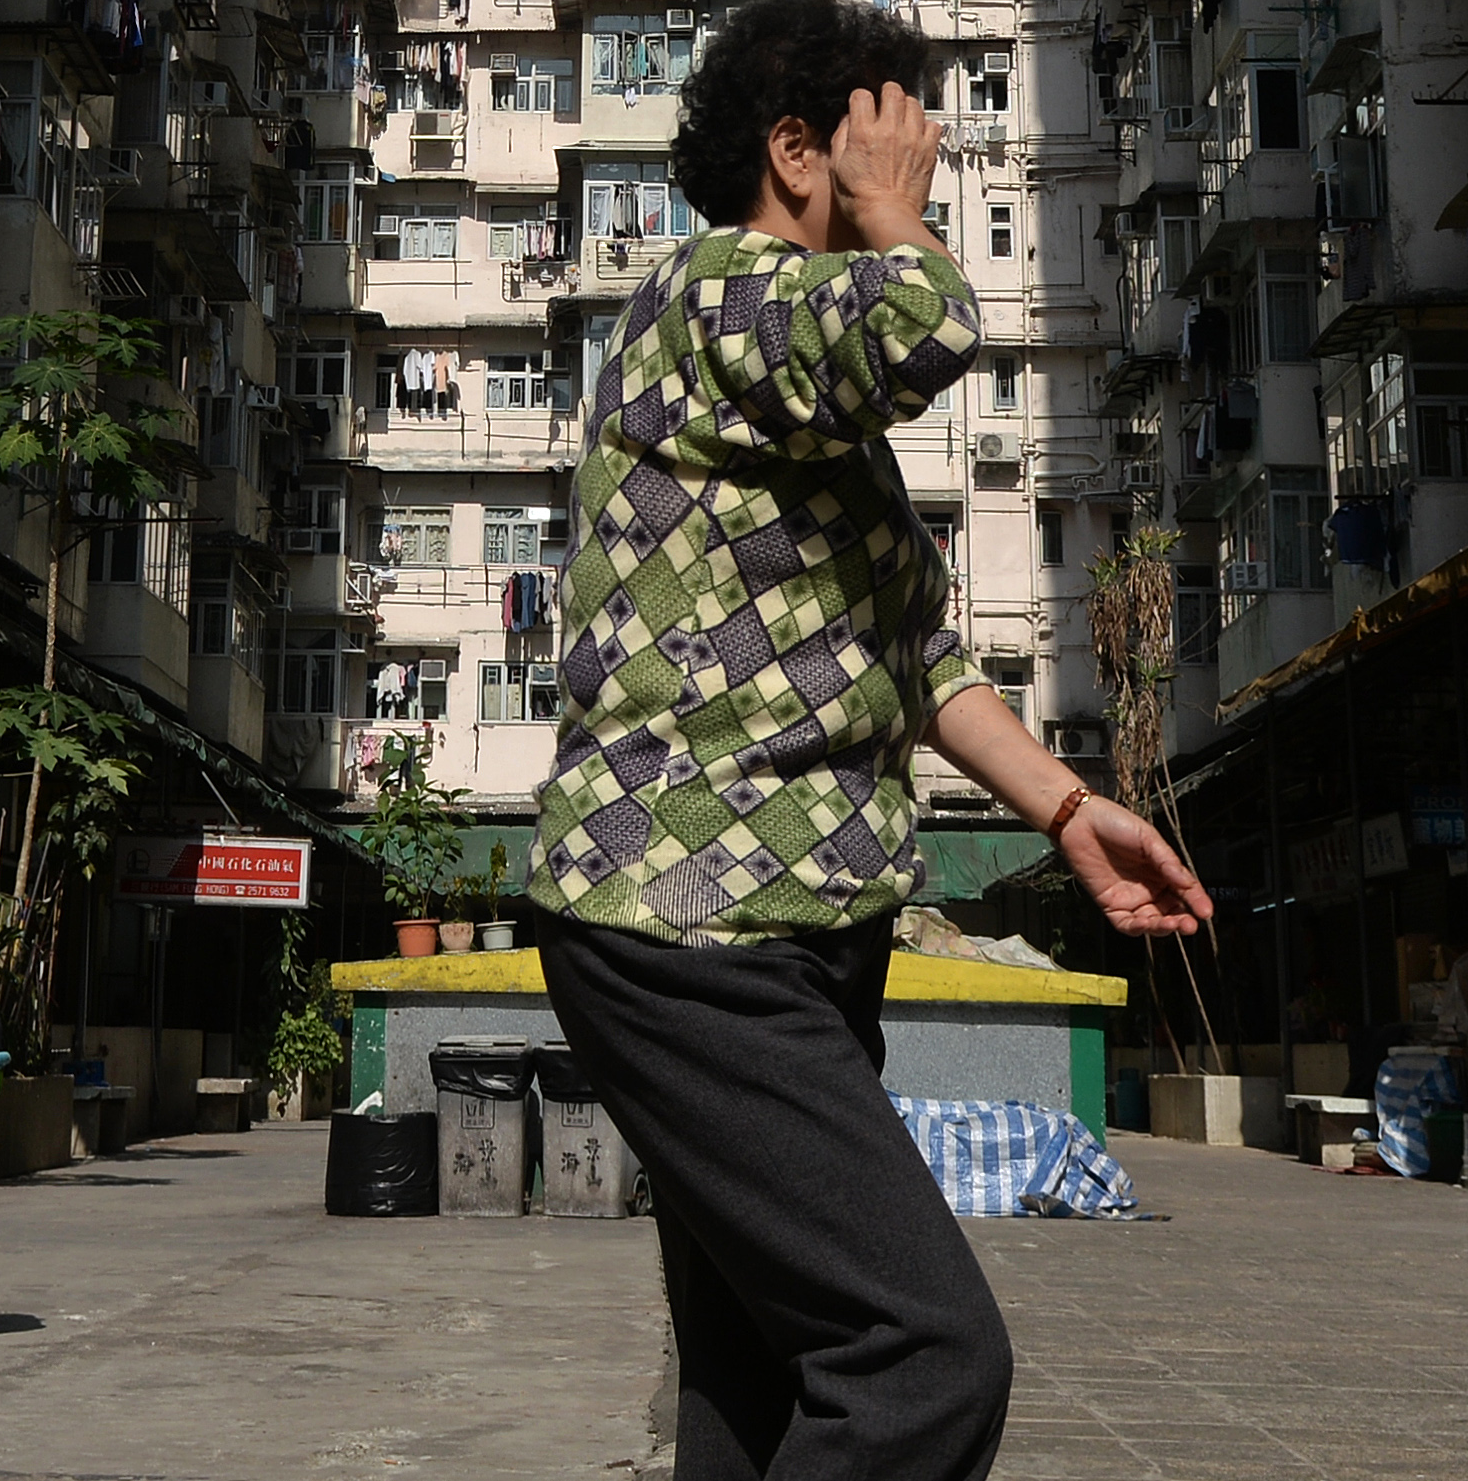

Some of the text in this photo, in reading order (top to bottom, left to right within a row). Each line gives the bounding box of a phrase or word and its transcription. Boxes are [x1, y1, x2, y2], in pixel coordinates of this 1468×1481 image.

[197, 854, 295, 875] 中國石化石油氣
[247, 886, 267, 896] 2571
[269, 887, 290, 897] 9632
